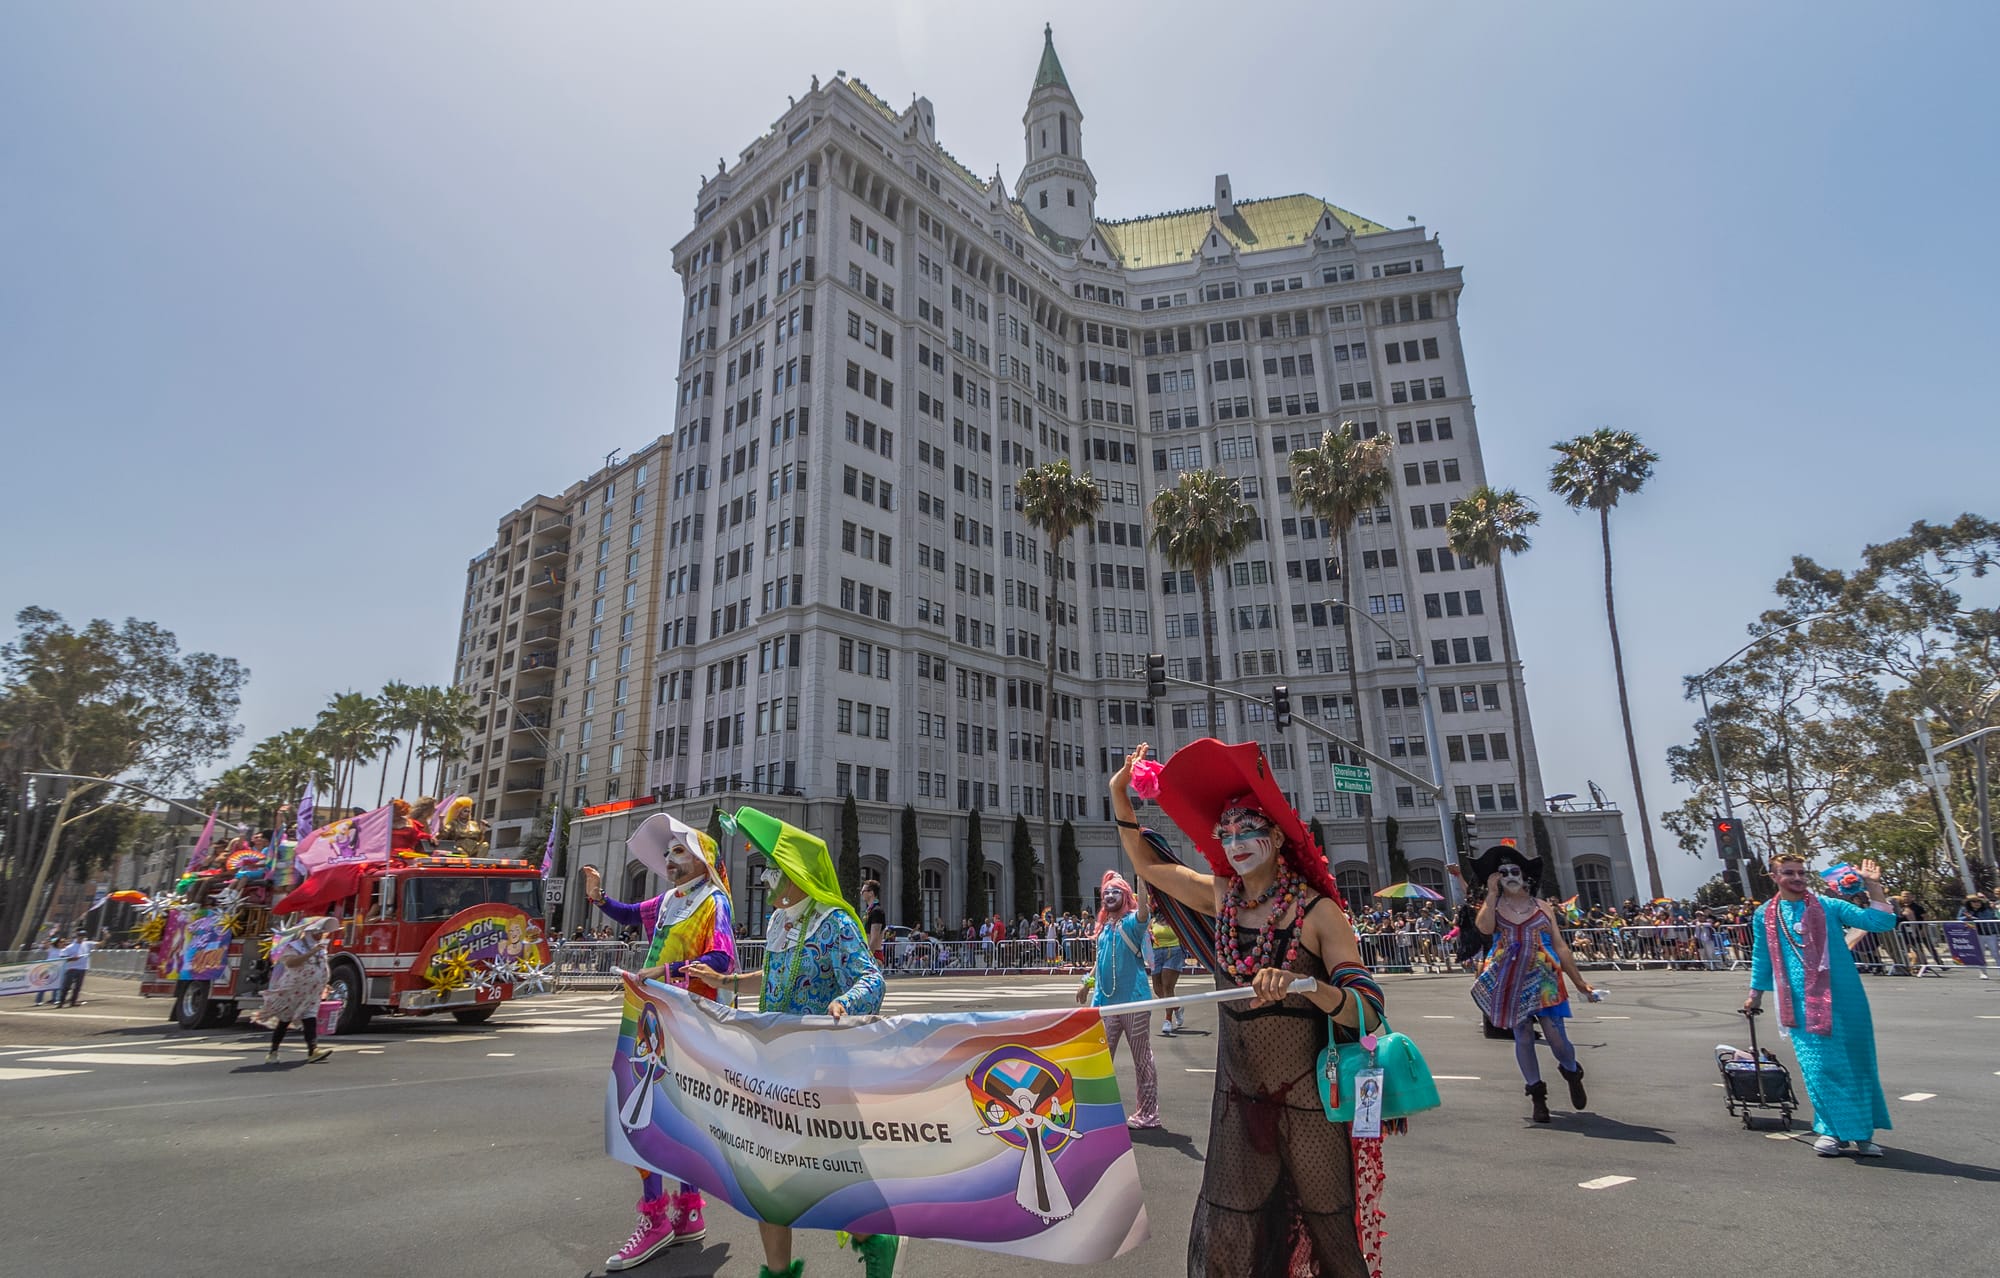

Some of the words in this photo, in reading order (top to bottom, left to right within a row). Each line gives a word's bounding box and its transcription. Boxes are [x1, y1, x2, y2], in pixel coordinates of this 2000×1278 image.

[1335, 766, 1357, 777] Shoreline
[1357, 769, 1363, 778] Dr
[1344, 780, 1364, 791] Alamitos
[546, 891, 562, 902] 30
[439, 928, 468, 949] IT'S
[472, 918, 494, 936] ON
[487, 986, 502, 1000] 26
[724, 1068, 743, 1089] THE
[743, 1075, 766, 1096] LOS
[764, 1083, 821, 1109] ANGELES
[675, 1071, 711, 1102] SISTERS
[713, 1087, 730, 1108] OF
[731, 1094, 803, 1136] PERPETUAL
[806, 1117, 952, 1144] INDULGENCE
[709, 1124, 755, 1155] PROMULGATE
[755, 1144, 773, 1162] JOY!
[774, 1151, 821, 1171] EXPIATE
[822, 1158, 864, 1174] GUILT!
